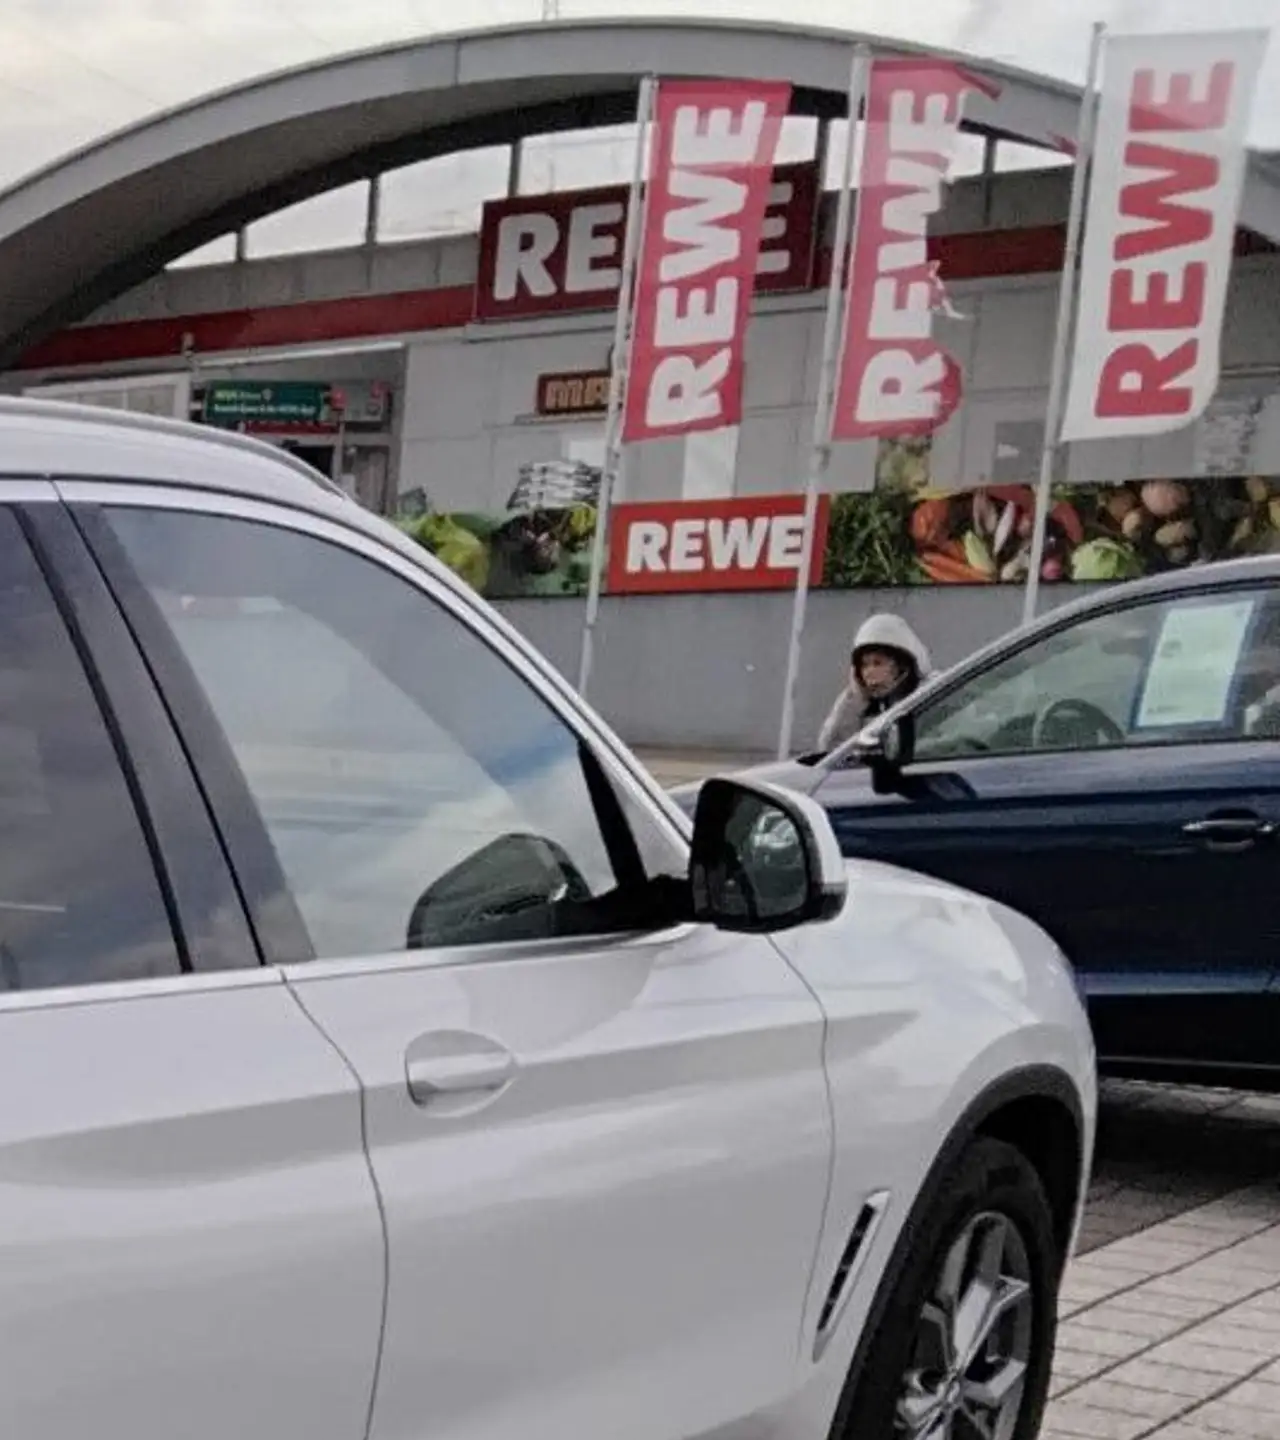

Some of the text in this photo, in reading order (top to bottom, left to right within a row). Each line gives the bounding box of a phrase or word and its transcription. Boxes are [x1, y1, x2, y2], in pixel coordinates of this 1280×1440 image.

[493, 182, 793, 301] REE
[645, 101, 767, 427] REWE
[1094, 61, 1234, 417] REWE
[626, 515, 808, 574] REWE
